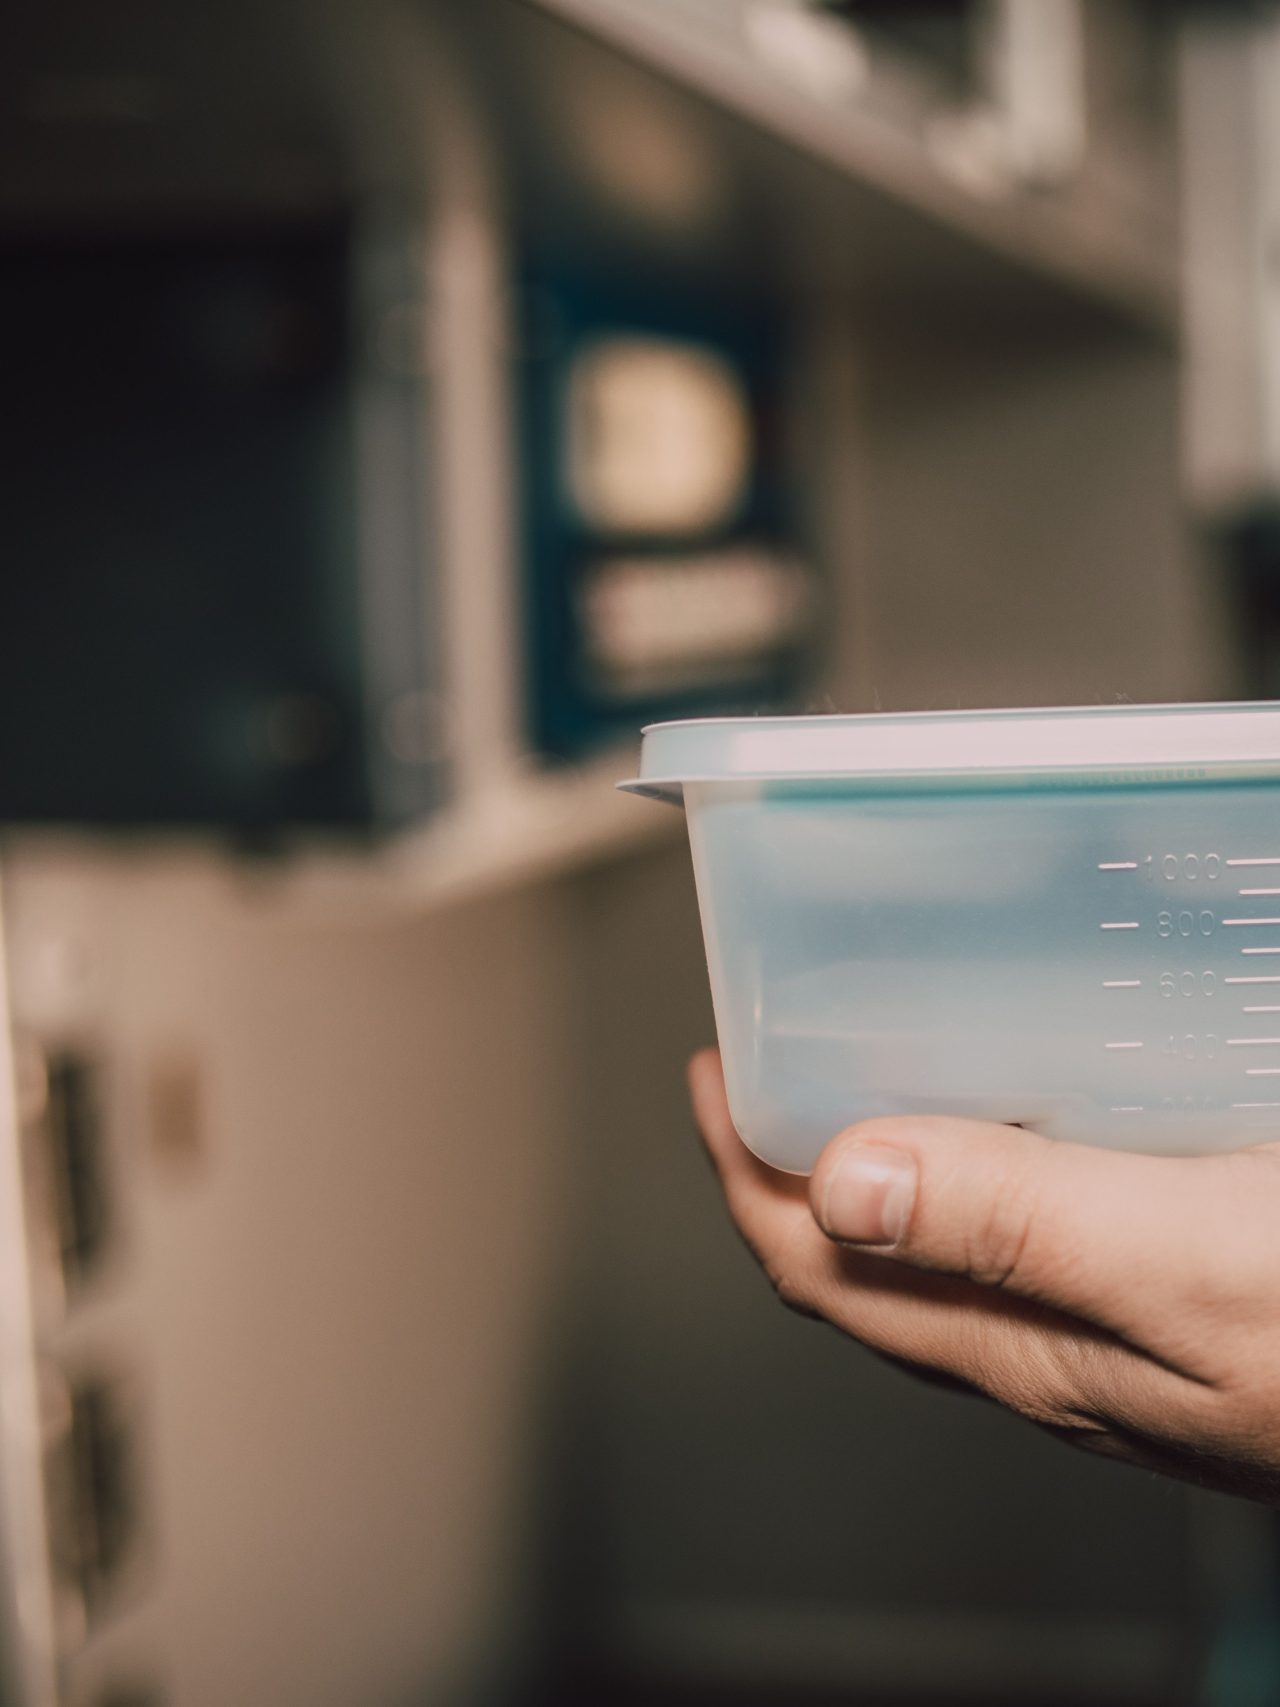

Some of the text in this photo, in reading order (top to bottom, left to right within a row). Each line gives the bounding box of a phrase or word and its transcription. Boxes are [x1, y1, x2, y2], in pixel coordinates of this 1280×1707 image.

[1143, 852, 1221, 881] 1000
[1156, 909, 1216, 938] 800
[1158, 970, 1218, 999] 600
